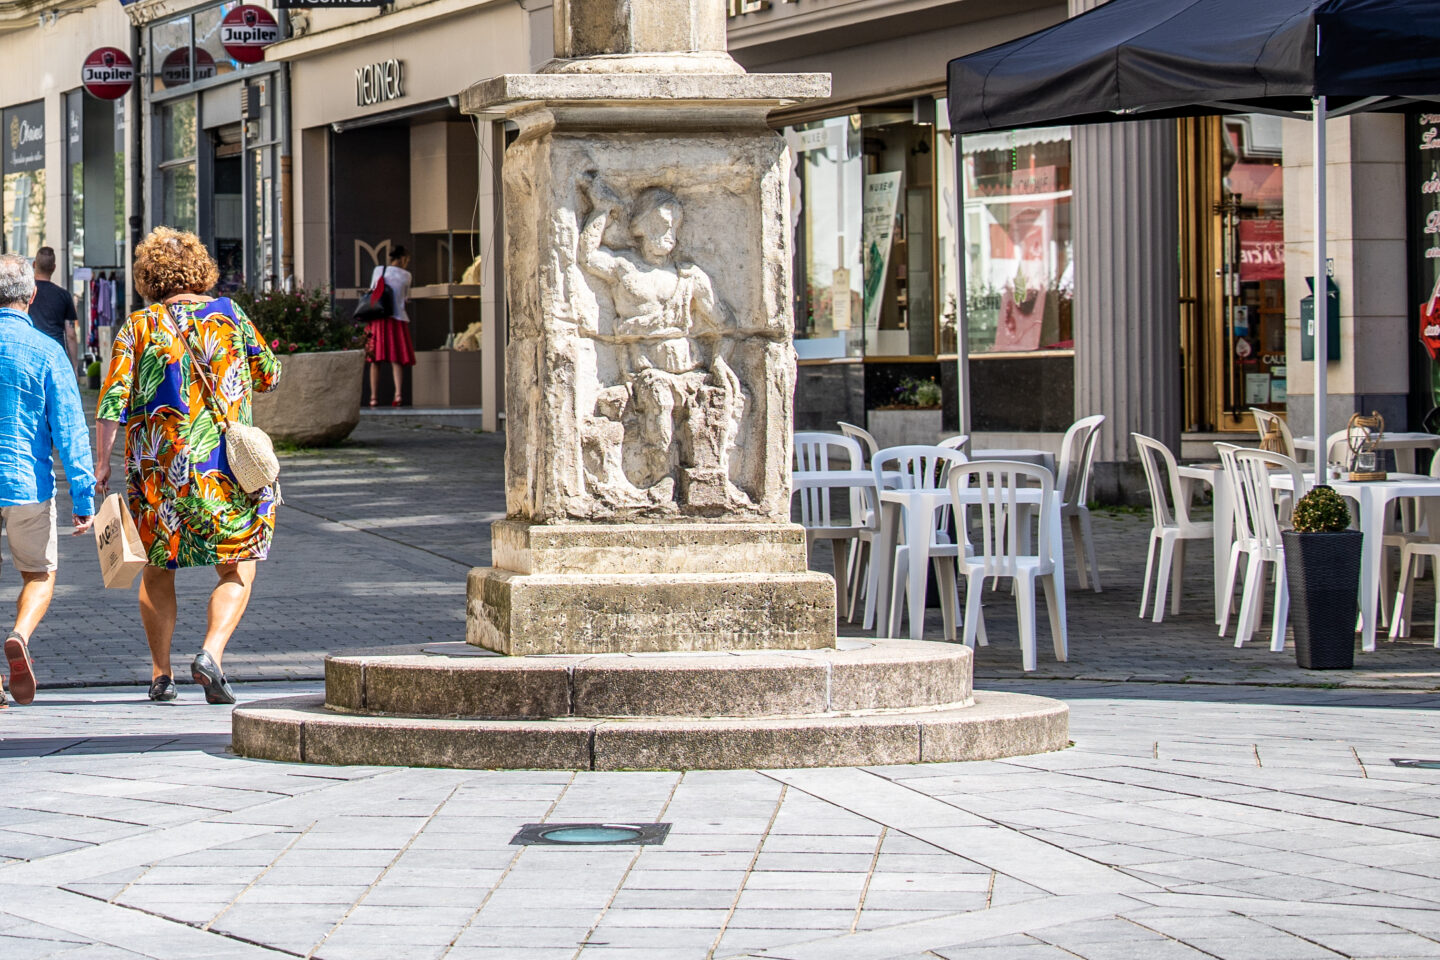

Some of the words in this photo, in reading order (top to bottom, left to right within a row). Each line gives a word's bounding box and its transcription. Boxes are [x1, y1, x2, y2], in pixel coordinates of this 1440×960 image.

[224, 28, 277, 43] Jupiler
[86, 67, 132, 82] Jupiler
[355, 58, 404, 107] MEUNIER
